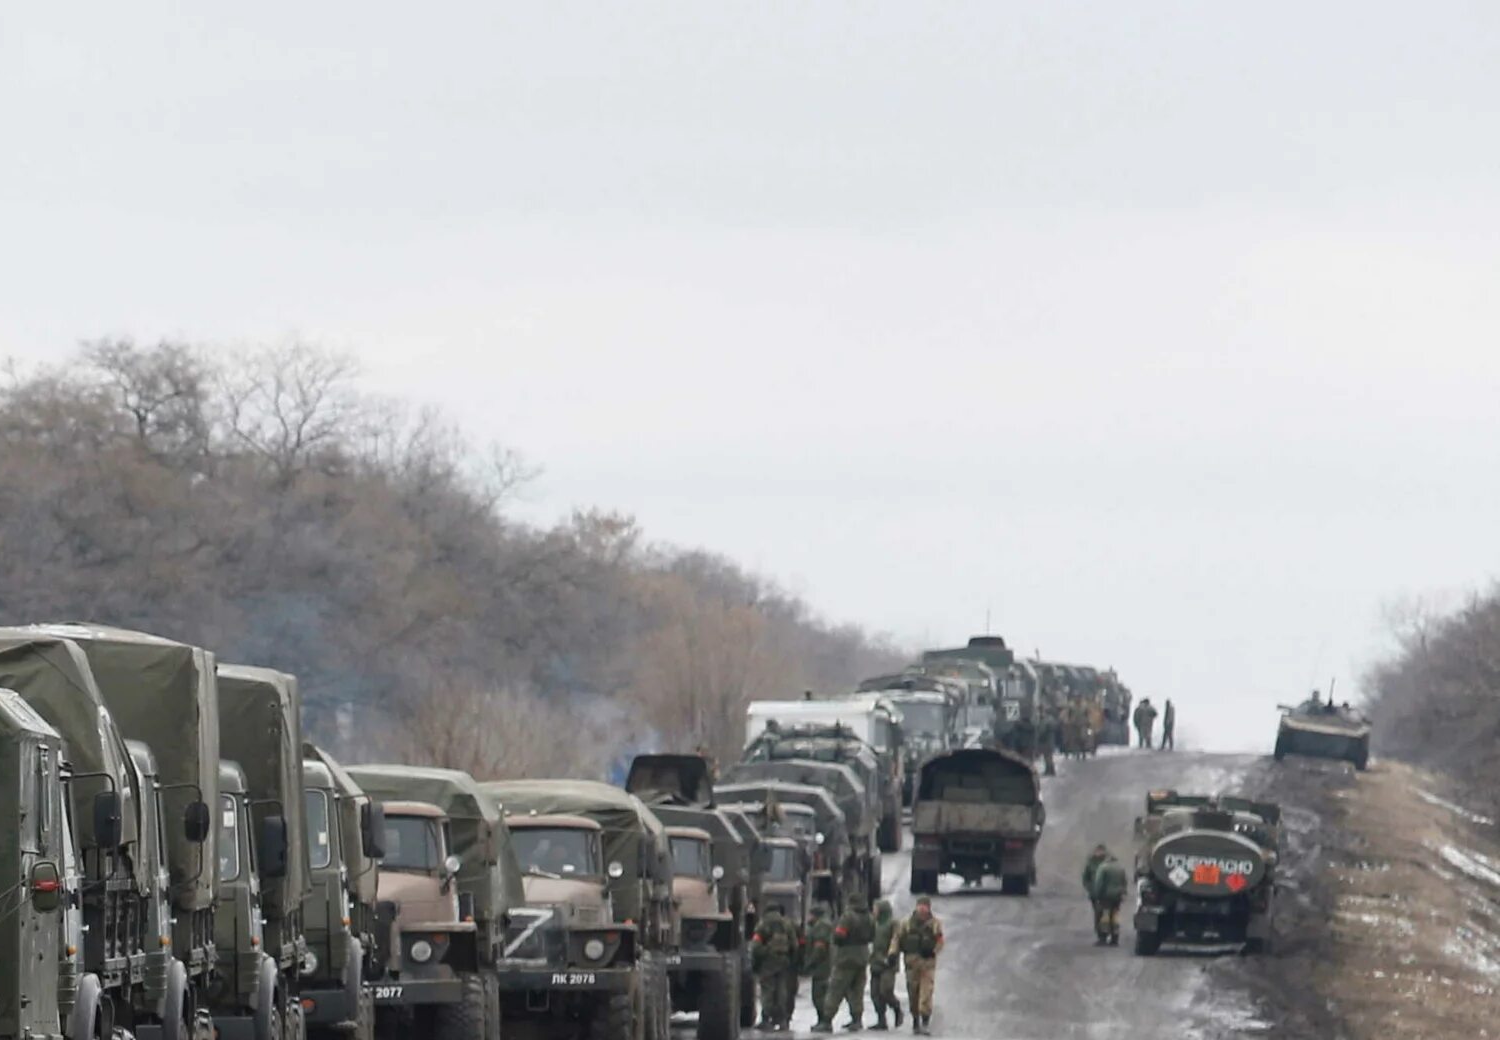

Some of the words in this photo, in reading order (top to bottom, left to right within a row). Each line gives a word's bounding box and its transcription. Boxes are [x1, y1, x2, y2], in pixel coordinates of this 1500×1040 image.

[497, 907, 554, 966] Z
[570, 973, 595, 984] 2078
[375, 987, 403, 998] 2077
